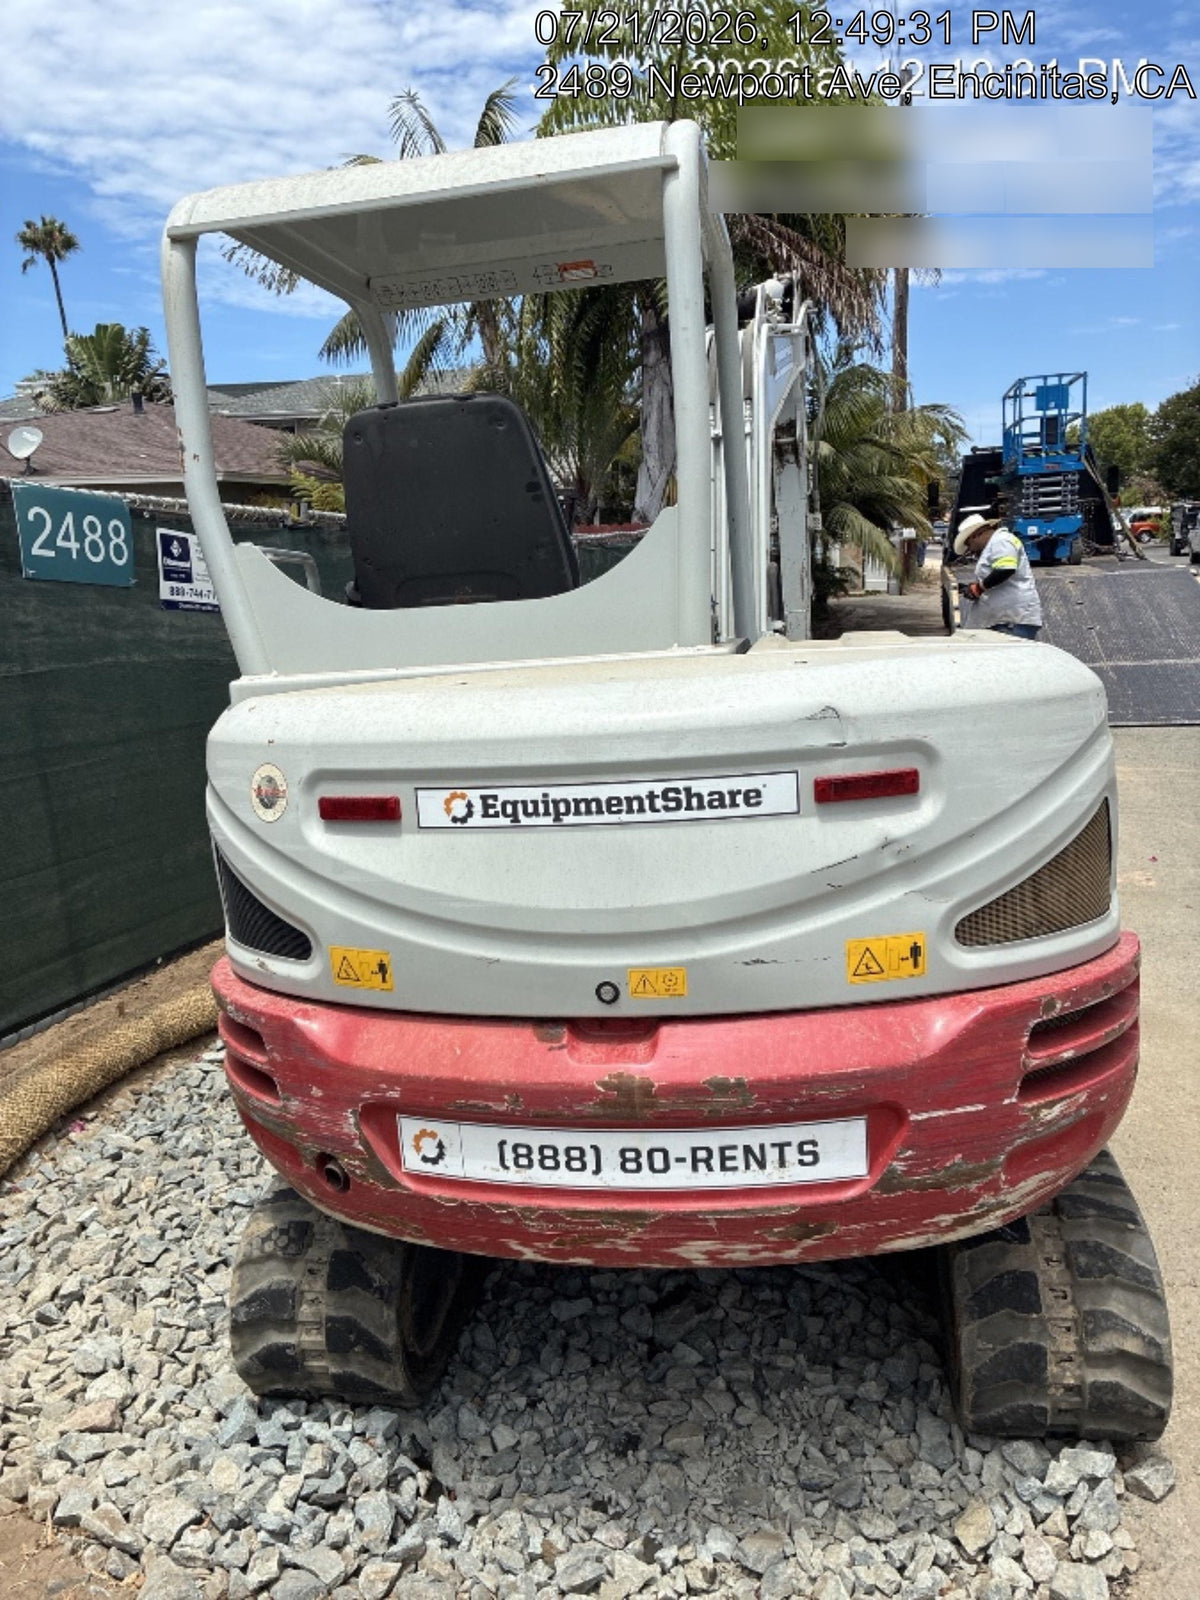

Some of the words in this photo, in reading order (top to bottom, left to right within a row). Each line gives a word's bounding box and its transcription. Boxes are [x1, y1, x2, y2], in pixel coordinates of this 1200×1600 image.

[27, 505, 129, 566] 2488
[480, 785, 764, 824] EquipmentShare
[496, 1138, 602, 1175] (888)
[619, 1138, 820, 1175] 80-RENTS
